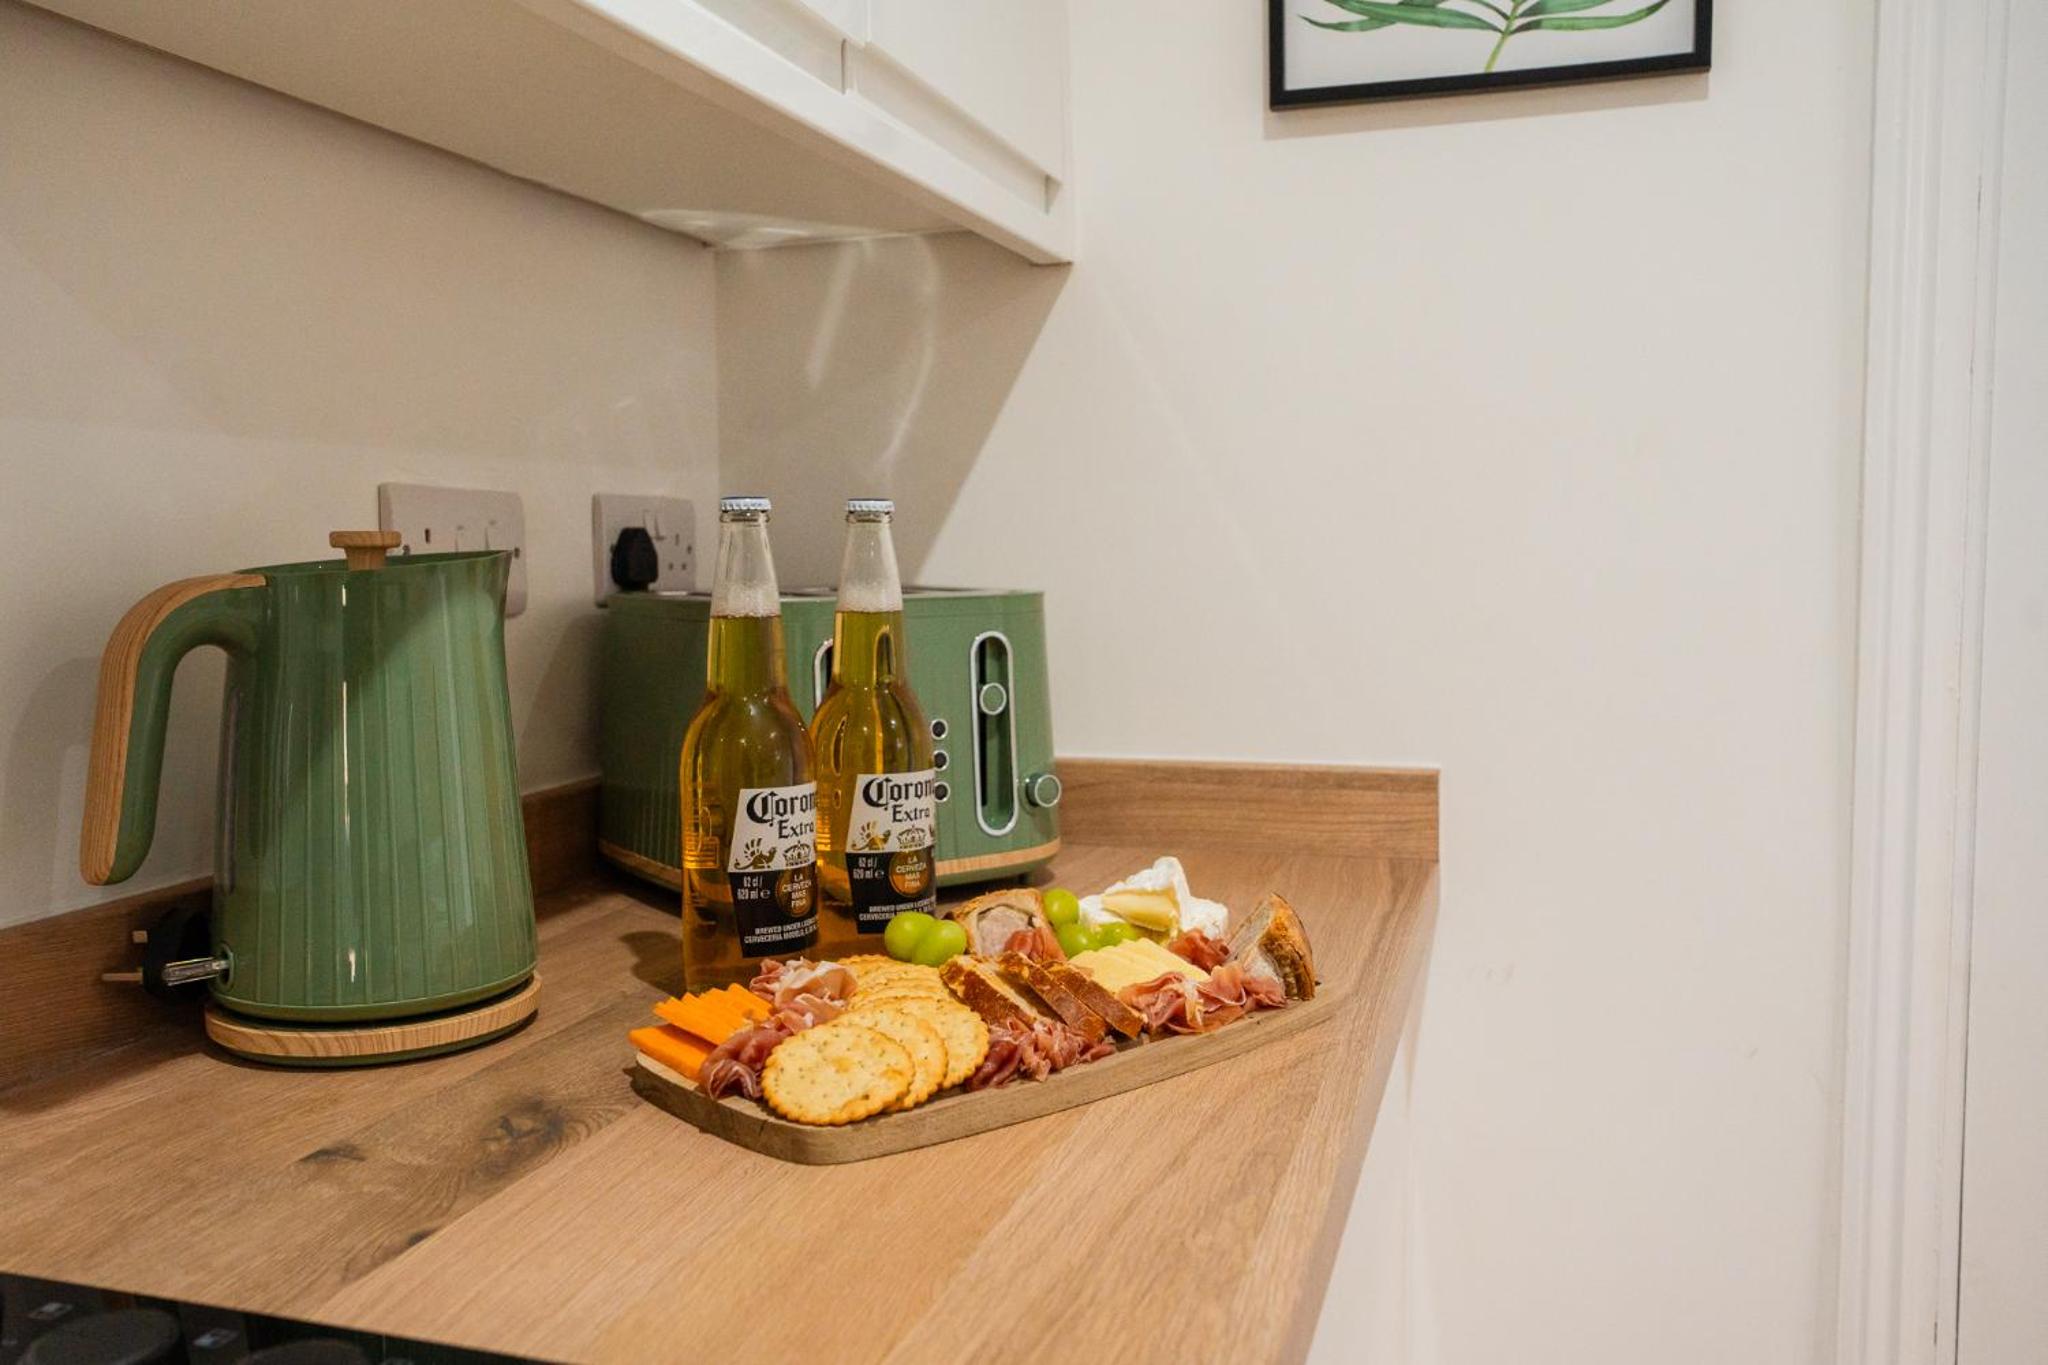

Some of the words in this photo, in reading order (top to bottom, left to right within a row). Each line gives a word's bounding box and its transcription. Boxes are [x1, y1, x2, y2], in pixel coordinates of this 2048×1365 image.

[862, 777, 935, 811] Coron
[892, 804, 930, 823] Extra
[778, 819, 814, 839] Extra
[907, 855, 919, 864] LA
[895, 862, 927, 873] CERVEZA
[793, 873, 804, 882] LA
[782, 880, 812, 893] CERVEZA
